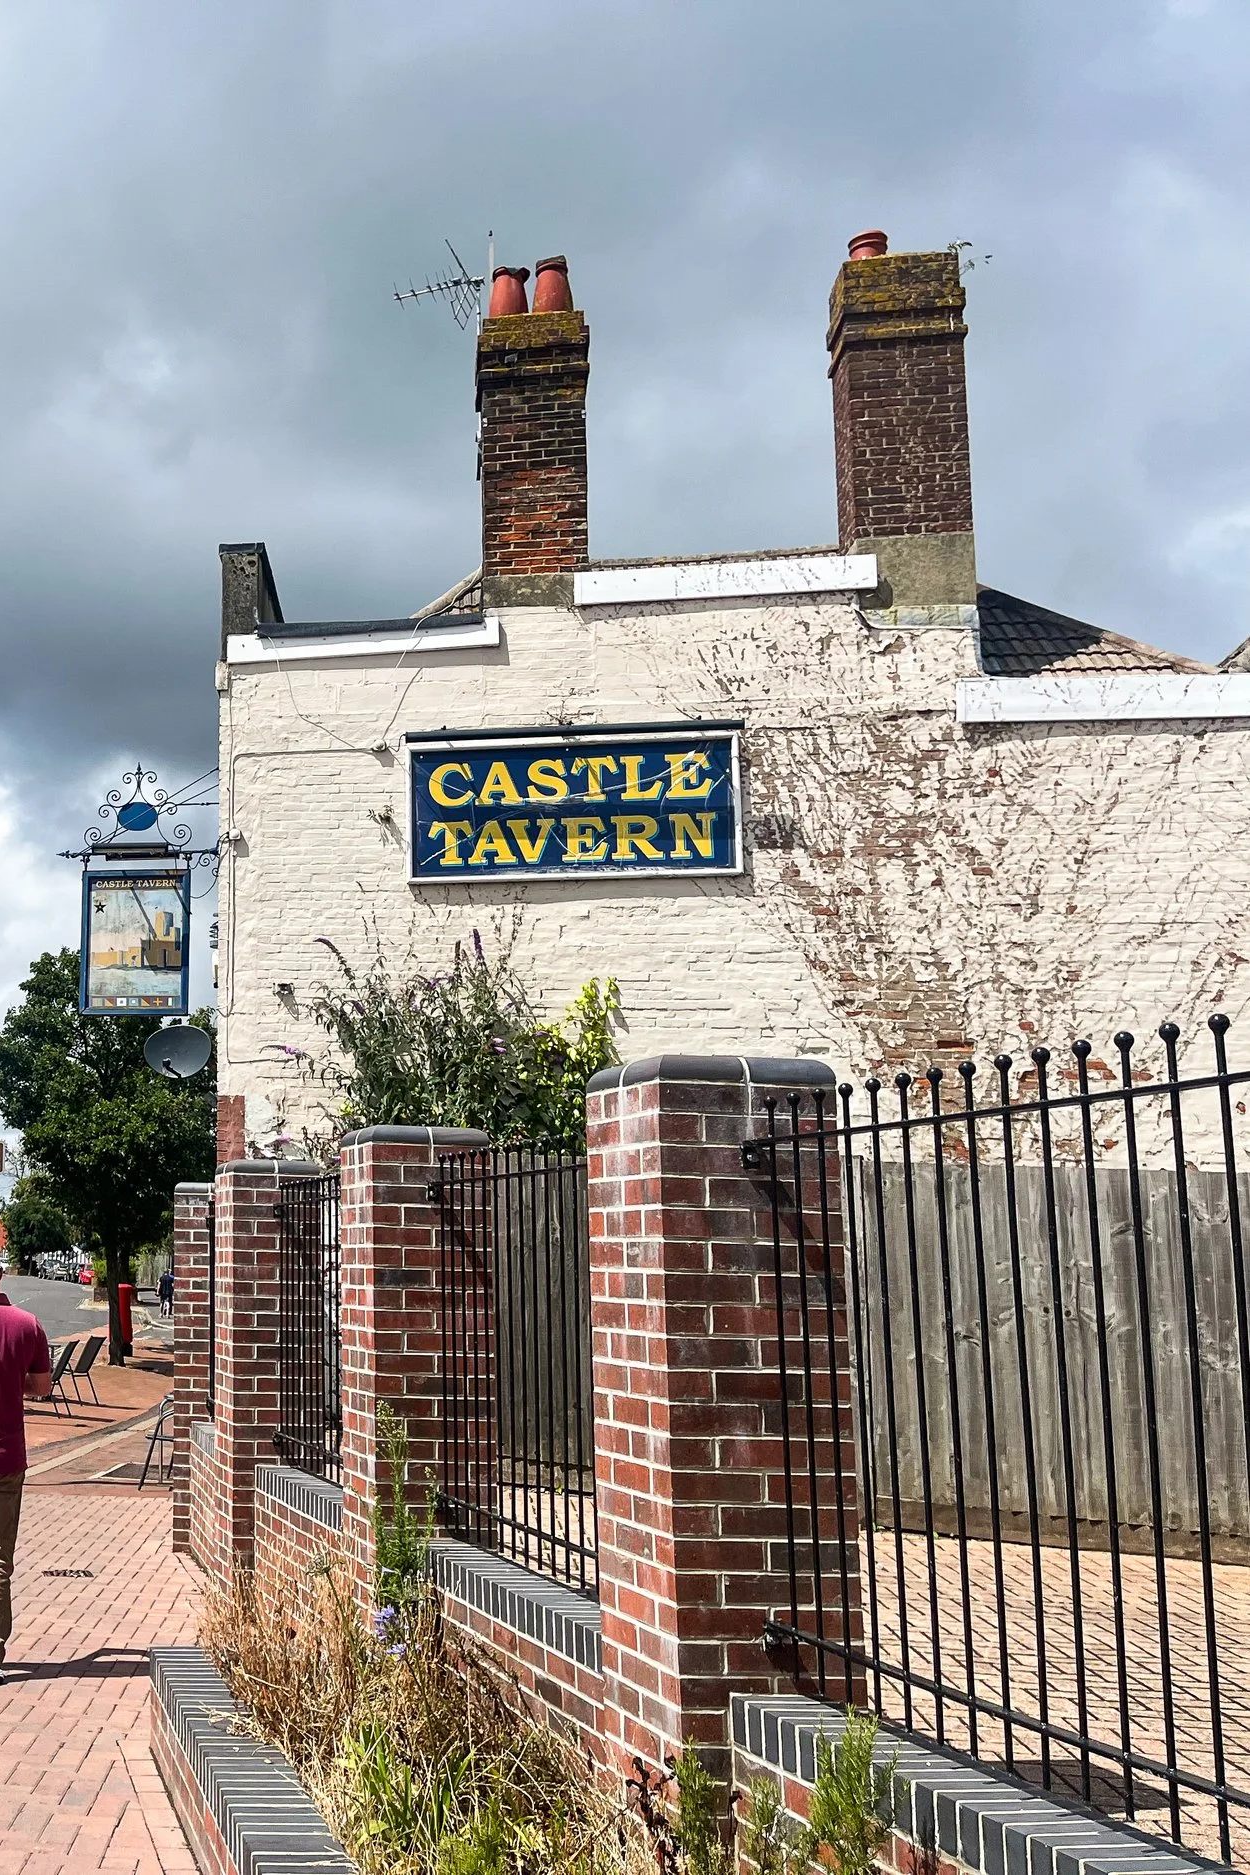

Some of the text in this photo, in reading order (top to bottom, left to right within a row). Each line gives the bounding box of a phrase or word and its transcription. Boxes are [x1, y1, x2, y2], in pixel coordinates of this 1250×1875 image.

[428, 753, 715, 808] CASTLE
[427, 811, 719, 867] TAVERN
[95, 879, 177, 889] CASTLE TAVERN
